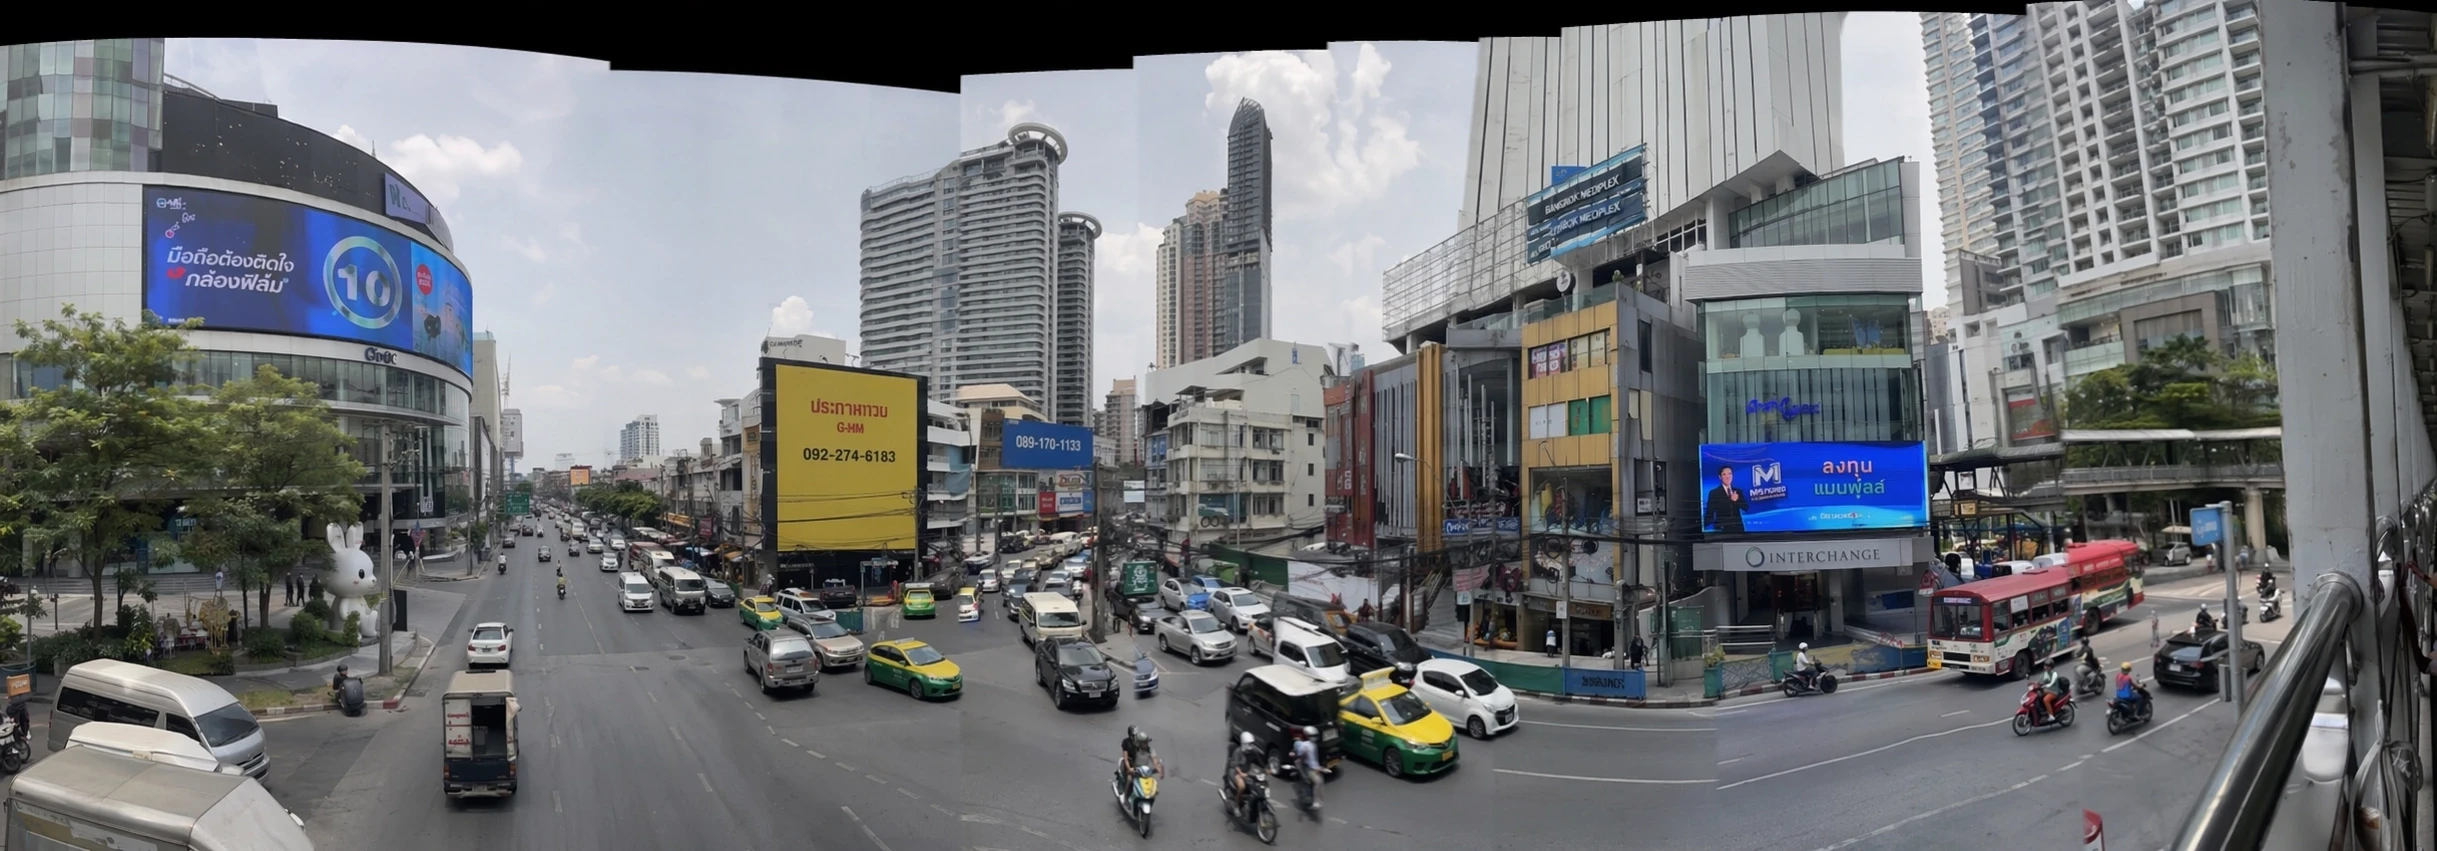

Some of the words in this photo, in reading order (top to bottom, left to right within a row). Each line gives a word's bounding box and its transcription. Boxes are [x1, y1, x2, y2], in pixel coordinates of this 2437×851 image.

[338, 264, 391, 307] 10
[1016, 436, 1081, 451] 089-170-1133
[803, 448, 896, 463] 092-274-6183
[1822, 460, 1873, 478] ลงทุน
[1770, 548, 1881, 564] INTERCHANGE
